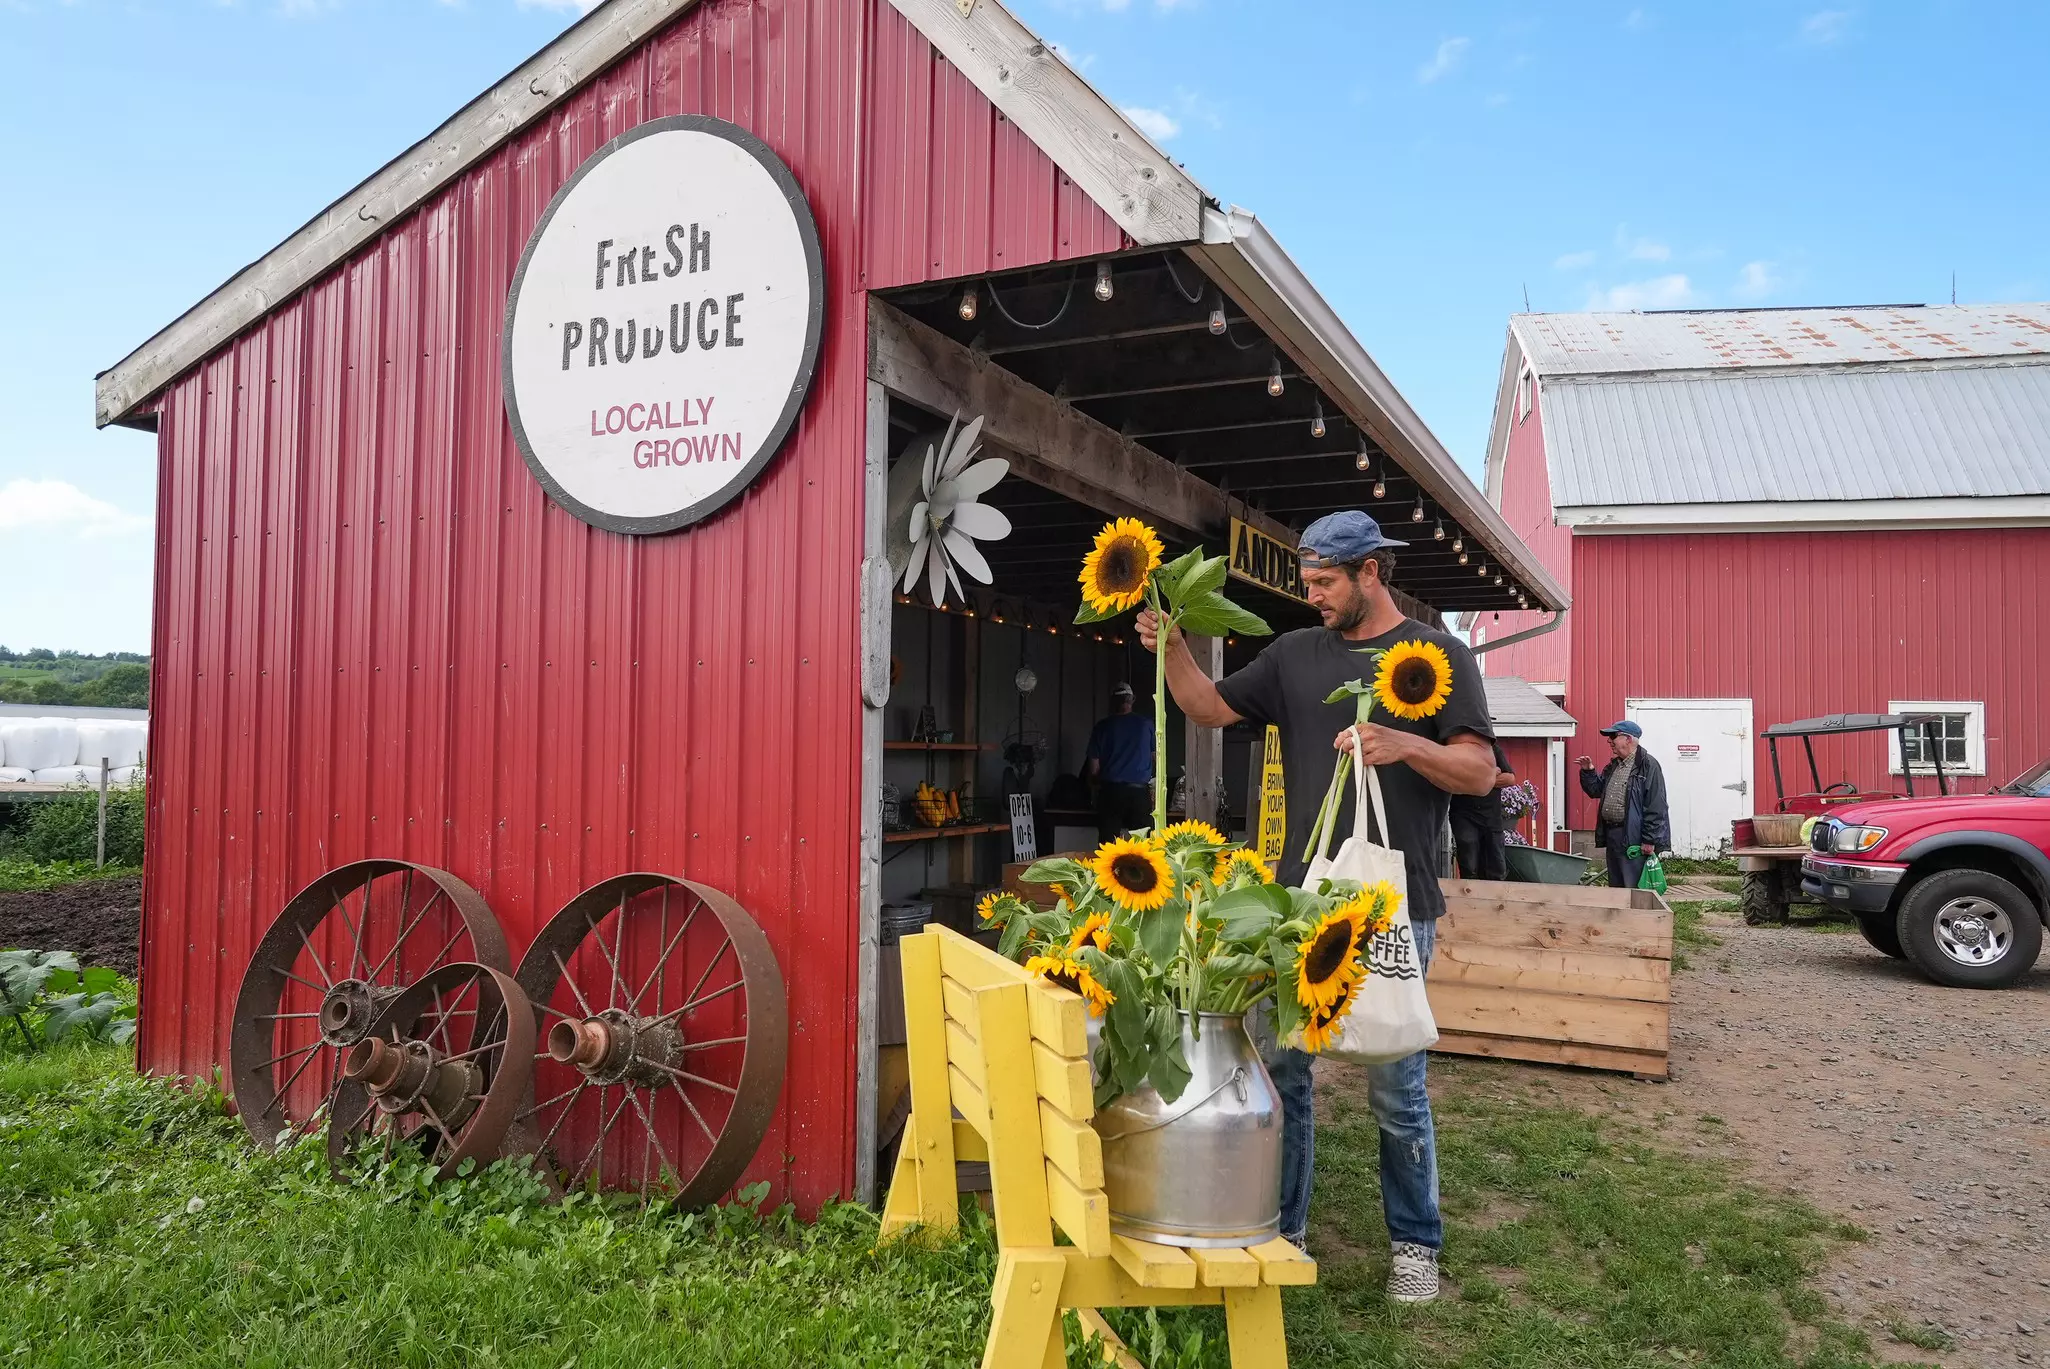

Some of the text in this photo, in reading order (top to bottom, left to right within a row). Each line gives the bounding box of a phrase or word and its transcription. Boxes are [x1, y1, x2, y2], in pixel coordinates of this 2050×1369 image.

[595, 222, 711, 291] FRESH
[561, 292, 745, 371] PRODUCE
[590, 396, 715, 437] LOCALLY
[633, 432, 742, 469] GROWN
[1011, 796, 1031, 817] OPEN
[1266, 795, 1284, 813] YOUR
[1016, 824, 1032, 846] 10-6
[1265, 817, 1282, 836] OWN
[1265, 837, 1281, 858] BAG
[1369, 940, 1409, 964] FFEE
